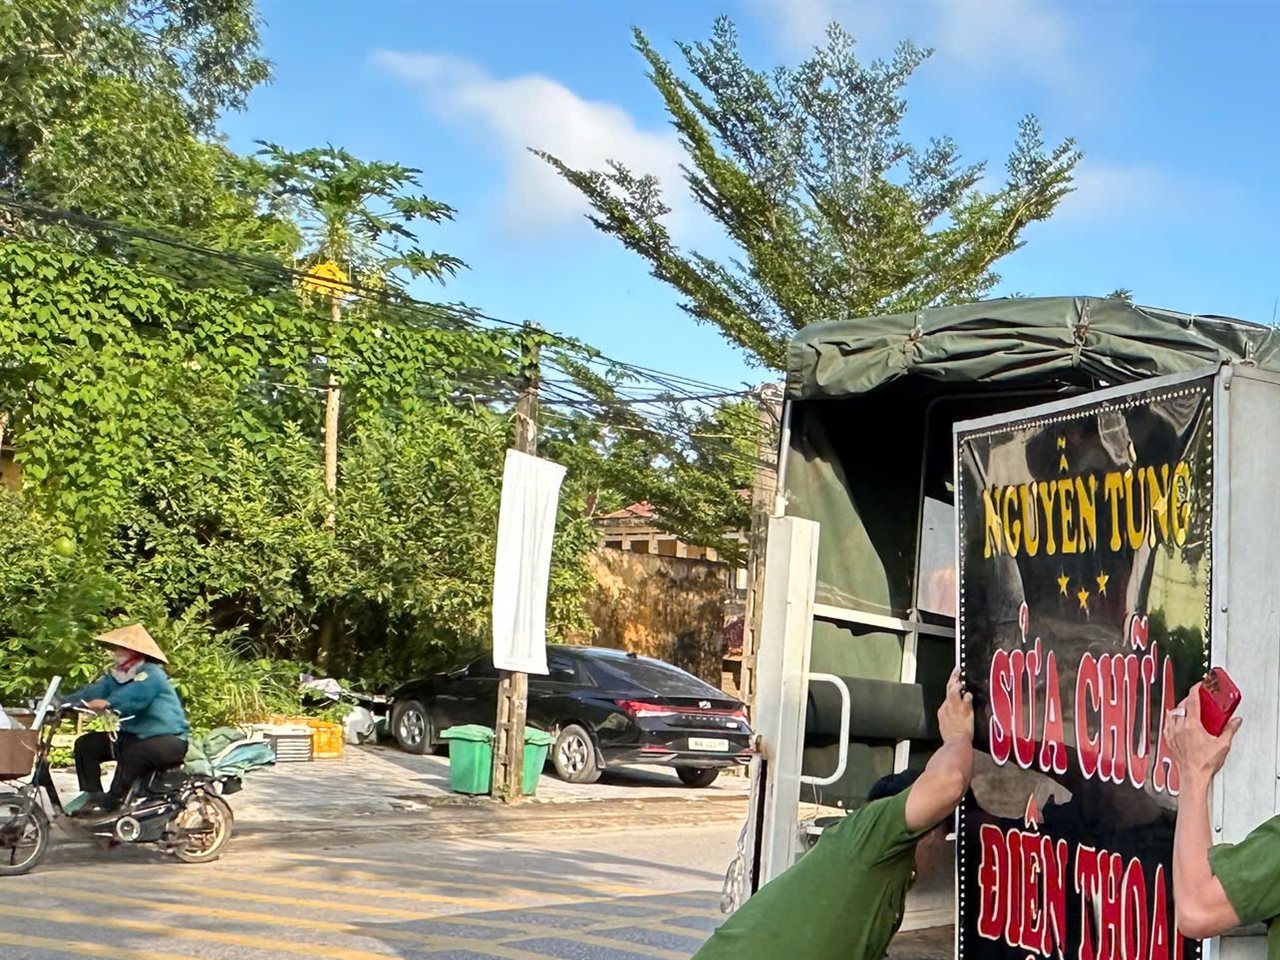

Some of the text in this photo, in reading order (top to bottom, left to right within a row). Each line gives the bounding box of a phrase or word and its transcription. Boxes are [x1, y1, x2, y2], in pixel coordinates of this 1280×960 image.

[982, 435, 1192, 559] NGUYỄN TÙNG
[989, 601, 1068, 775] SỬA
